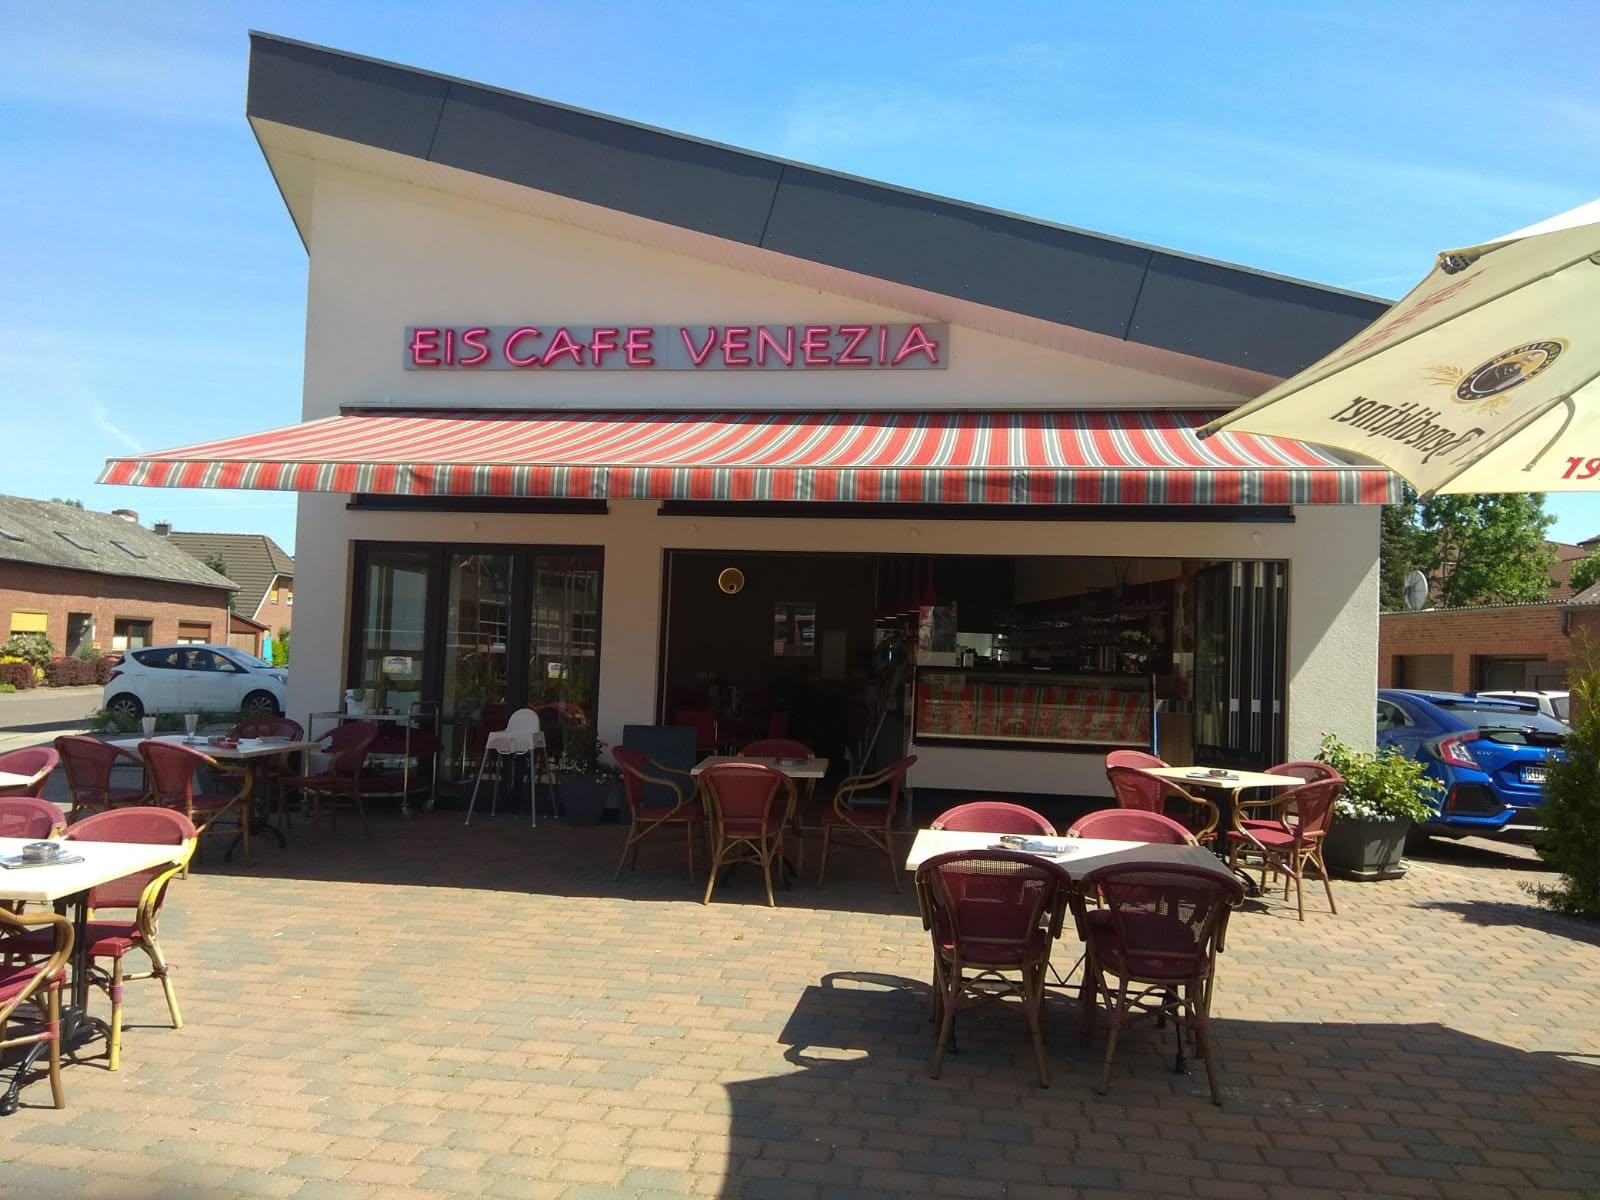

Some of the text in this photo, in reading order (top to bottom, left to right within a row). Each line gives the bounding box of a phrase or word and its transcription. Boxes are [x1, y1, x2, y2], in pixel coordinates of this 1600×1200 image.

[409, 324, 939, 367] EIS CAFE VENEZIA
